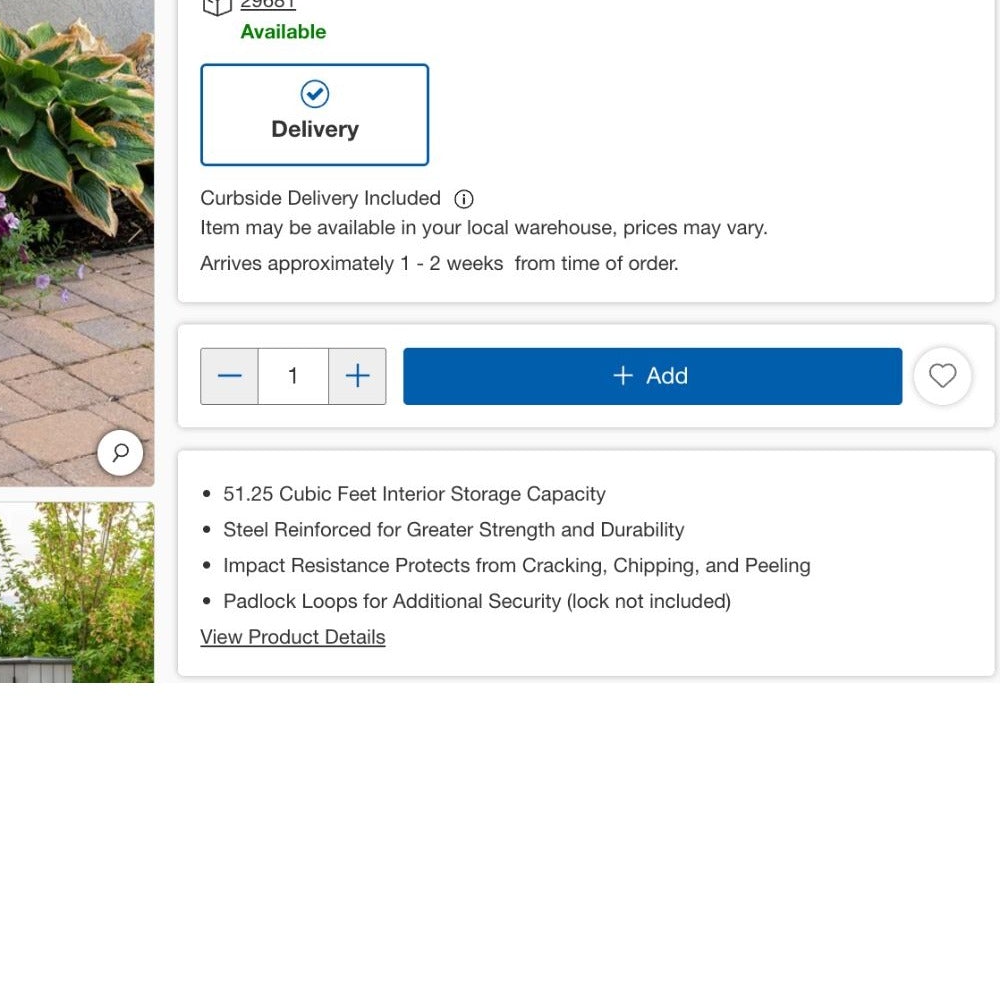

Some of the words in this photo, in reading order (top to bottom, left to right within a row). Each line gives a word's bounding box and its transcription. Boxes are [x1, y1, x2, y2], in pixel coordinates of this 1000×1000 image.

[240, 23, 327, 40] Available
[271, 119, 360, 142] Delivery
[200, 189, 282, 206] Curbside
[288, 189, 359, 210] Delivery
[365, 189, 441, 206] Included
[201, 219, 240, 235] Item
[245, 222, 284, 240] may
[289, 219, 312, 235] be
[317, 219, 396, 236] available
[401, 219, 416, 235] in
[421, 222, 462, 240] your
[467, 219, 509, 235] local
[514, 219, 617, 238] warehouse,
[623, 219, 678, 240] prices
[683, 222, 722, 240] may
[726, 222, 768, 240] vary.
[199, 255, 262, 271] Arrives
[267, 255, 395, 275] approximately
[401, 255, 408, 271] 1
[429, 255, 441, 271] 2
[446, 255, 504, 271] weeks
[514, 254, 556, 271] from
[560, 255, 600, 271] time
[605, 254, 624, 271] of
[628, 255, 679, 271] order.
[288, 366, 296, 385] 1
[646, 366, 688, 385] Add
[223, 485, 274, 502] 51.25
[279, 485, 332, 502] Cubic
[338, 485, 377, 502] Feet
[383, 485, 446, 502] Interior
[450, 485, 522, 506] Storage
[526, 485, 607, 506] Capacity
[223, 521, 268, 538] Steel
[274, 521, 371, 538] Reinforced
[376, 521, 402, 538] for
[406, 521, 474, 538] Greater
[479, 521, 555, 542] Strength
[561, 521, 595, 538] and
[601, 521, 685, 542] Durability
[224, 557, 286, 577] Impact
[291, 557, 390, 573] Resistance
[395, 557, 471, 573] Protects
[475, 557, 516, 573] from
[522, 557, 607, 578] Cracking,
[613, 556, 699, 578] Chipping,
[705, 557, 739, 573] and
[745, 557, 811, 577] Peeling
[224, 592, 297, 609] Padlock
[302, 592, 358, 613] Loops
[362, 592, 388, 609] for
[392, 592, 483, 609] Additional
[488, 592, 562, 613] Security
[567, 592, 610, 613] (lock
[615, 593, 644, 609] not
[649, 592, 731, 613] included)
[199, 628, 243, 645] View
[248, 628, 320, 645] Product
[325, 628, 386, 645] Details
